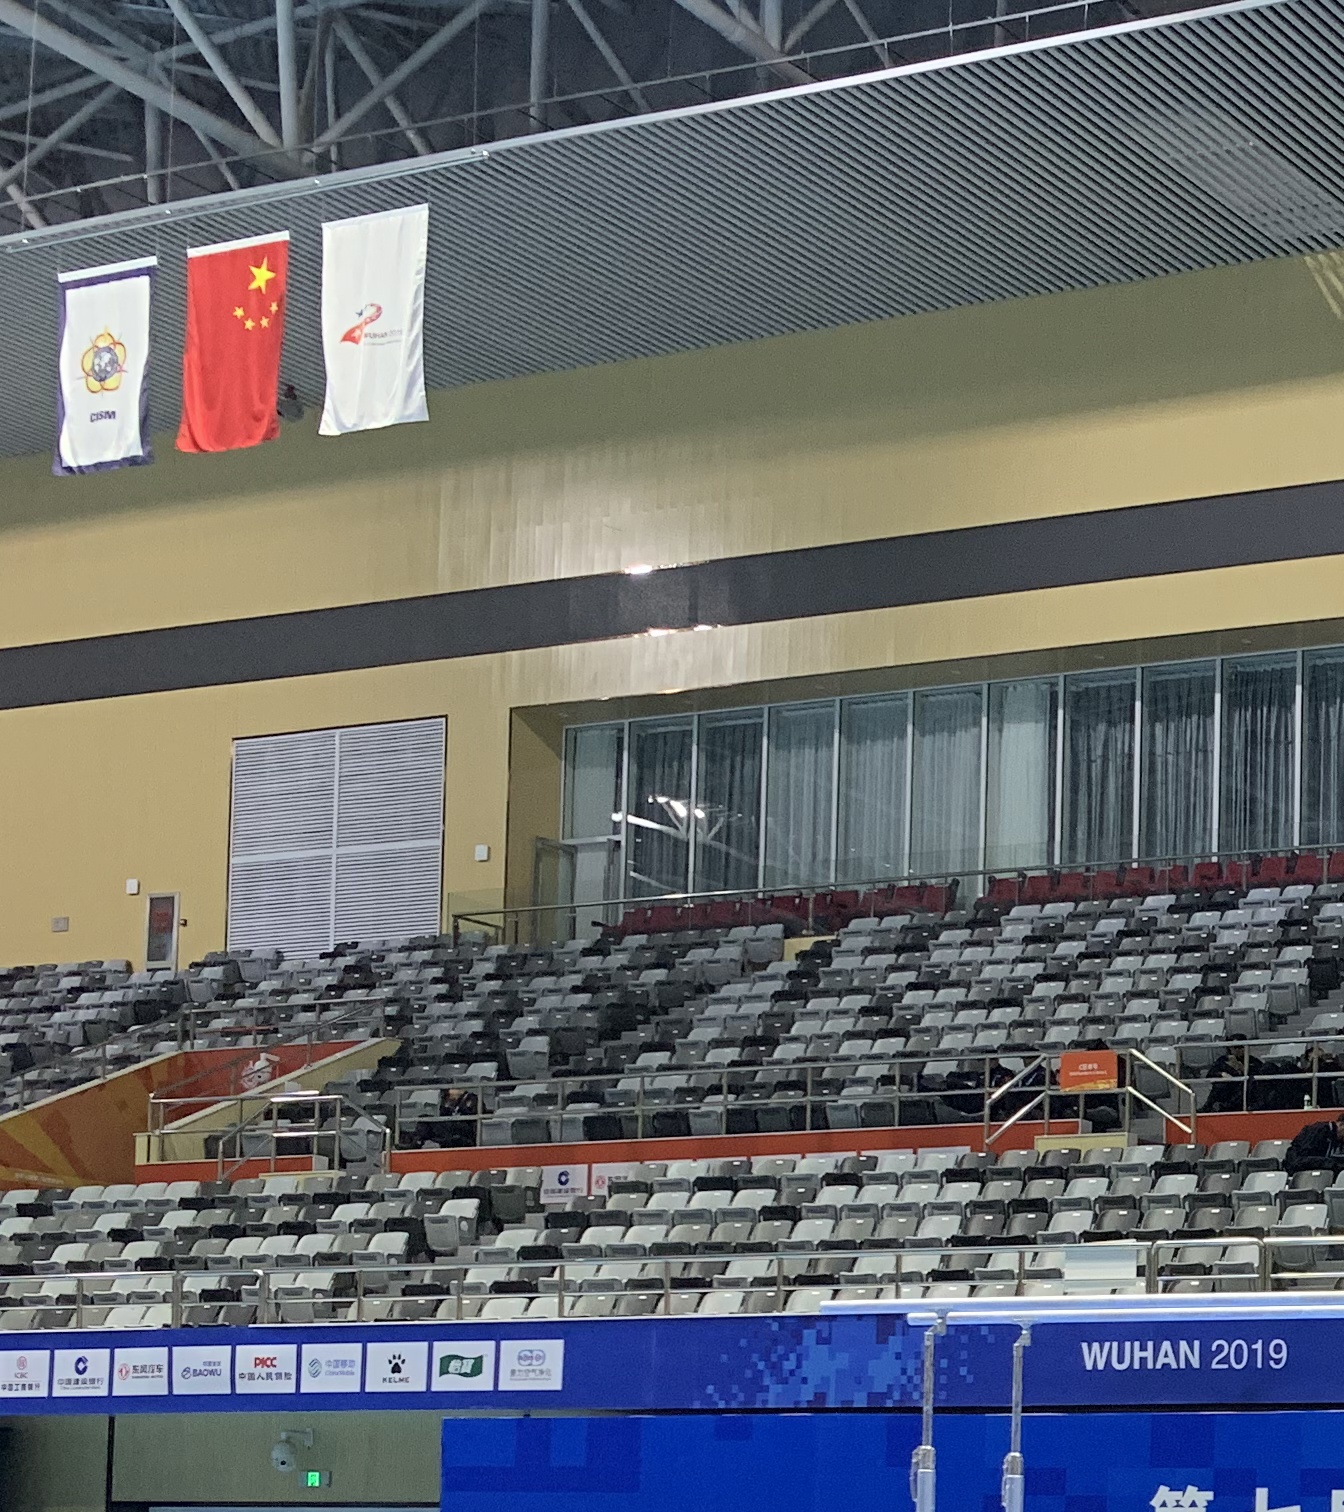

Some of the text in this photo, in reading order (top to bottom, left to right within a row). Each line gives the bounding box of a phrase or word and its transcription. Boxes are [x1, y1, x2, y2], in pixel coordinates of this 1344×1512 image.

[254, 1356, 277, 1368] PICC
[1081, 1338, 1288, 1372] WUHAN 2019
